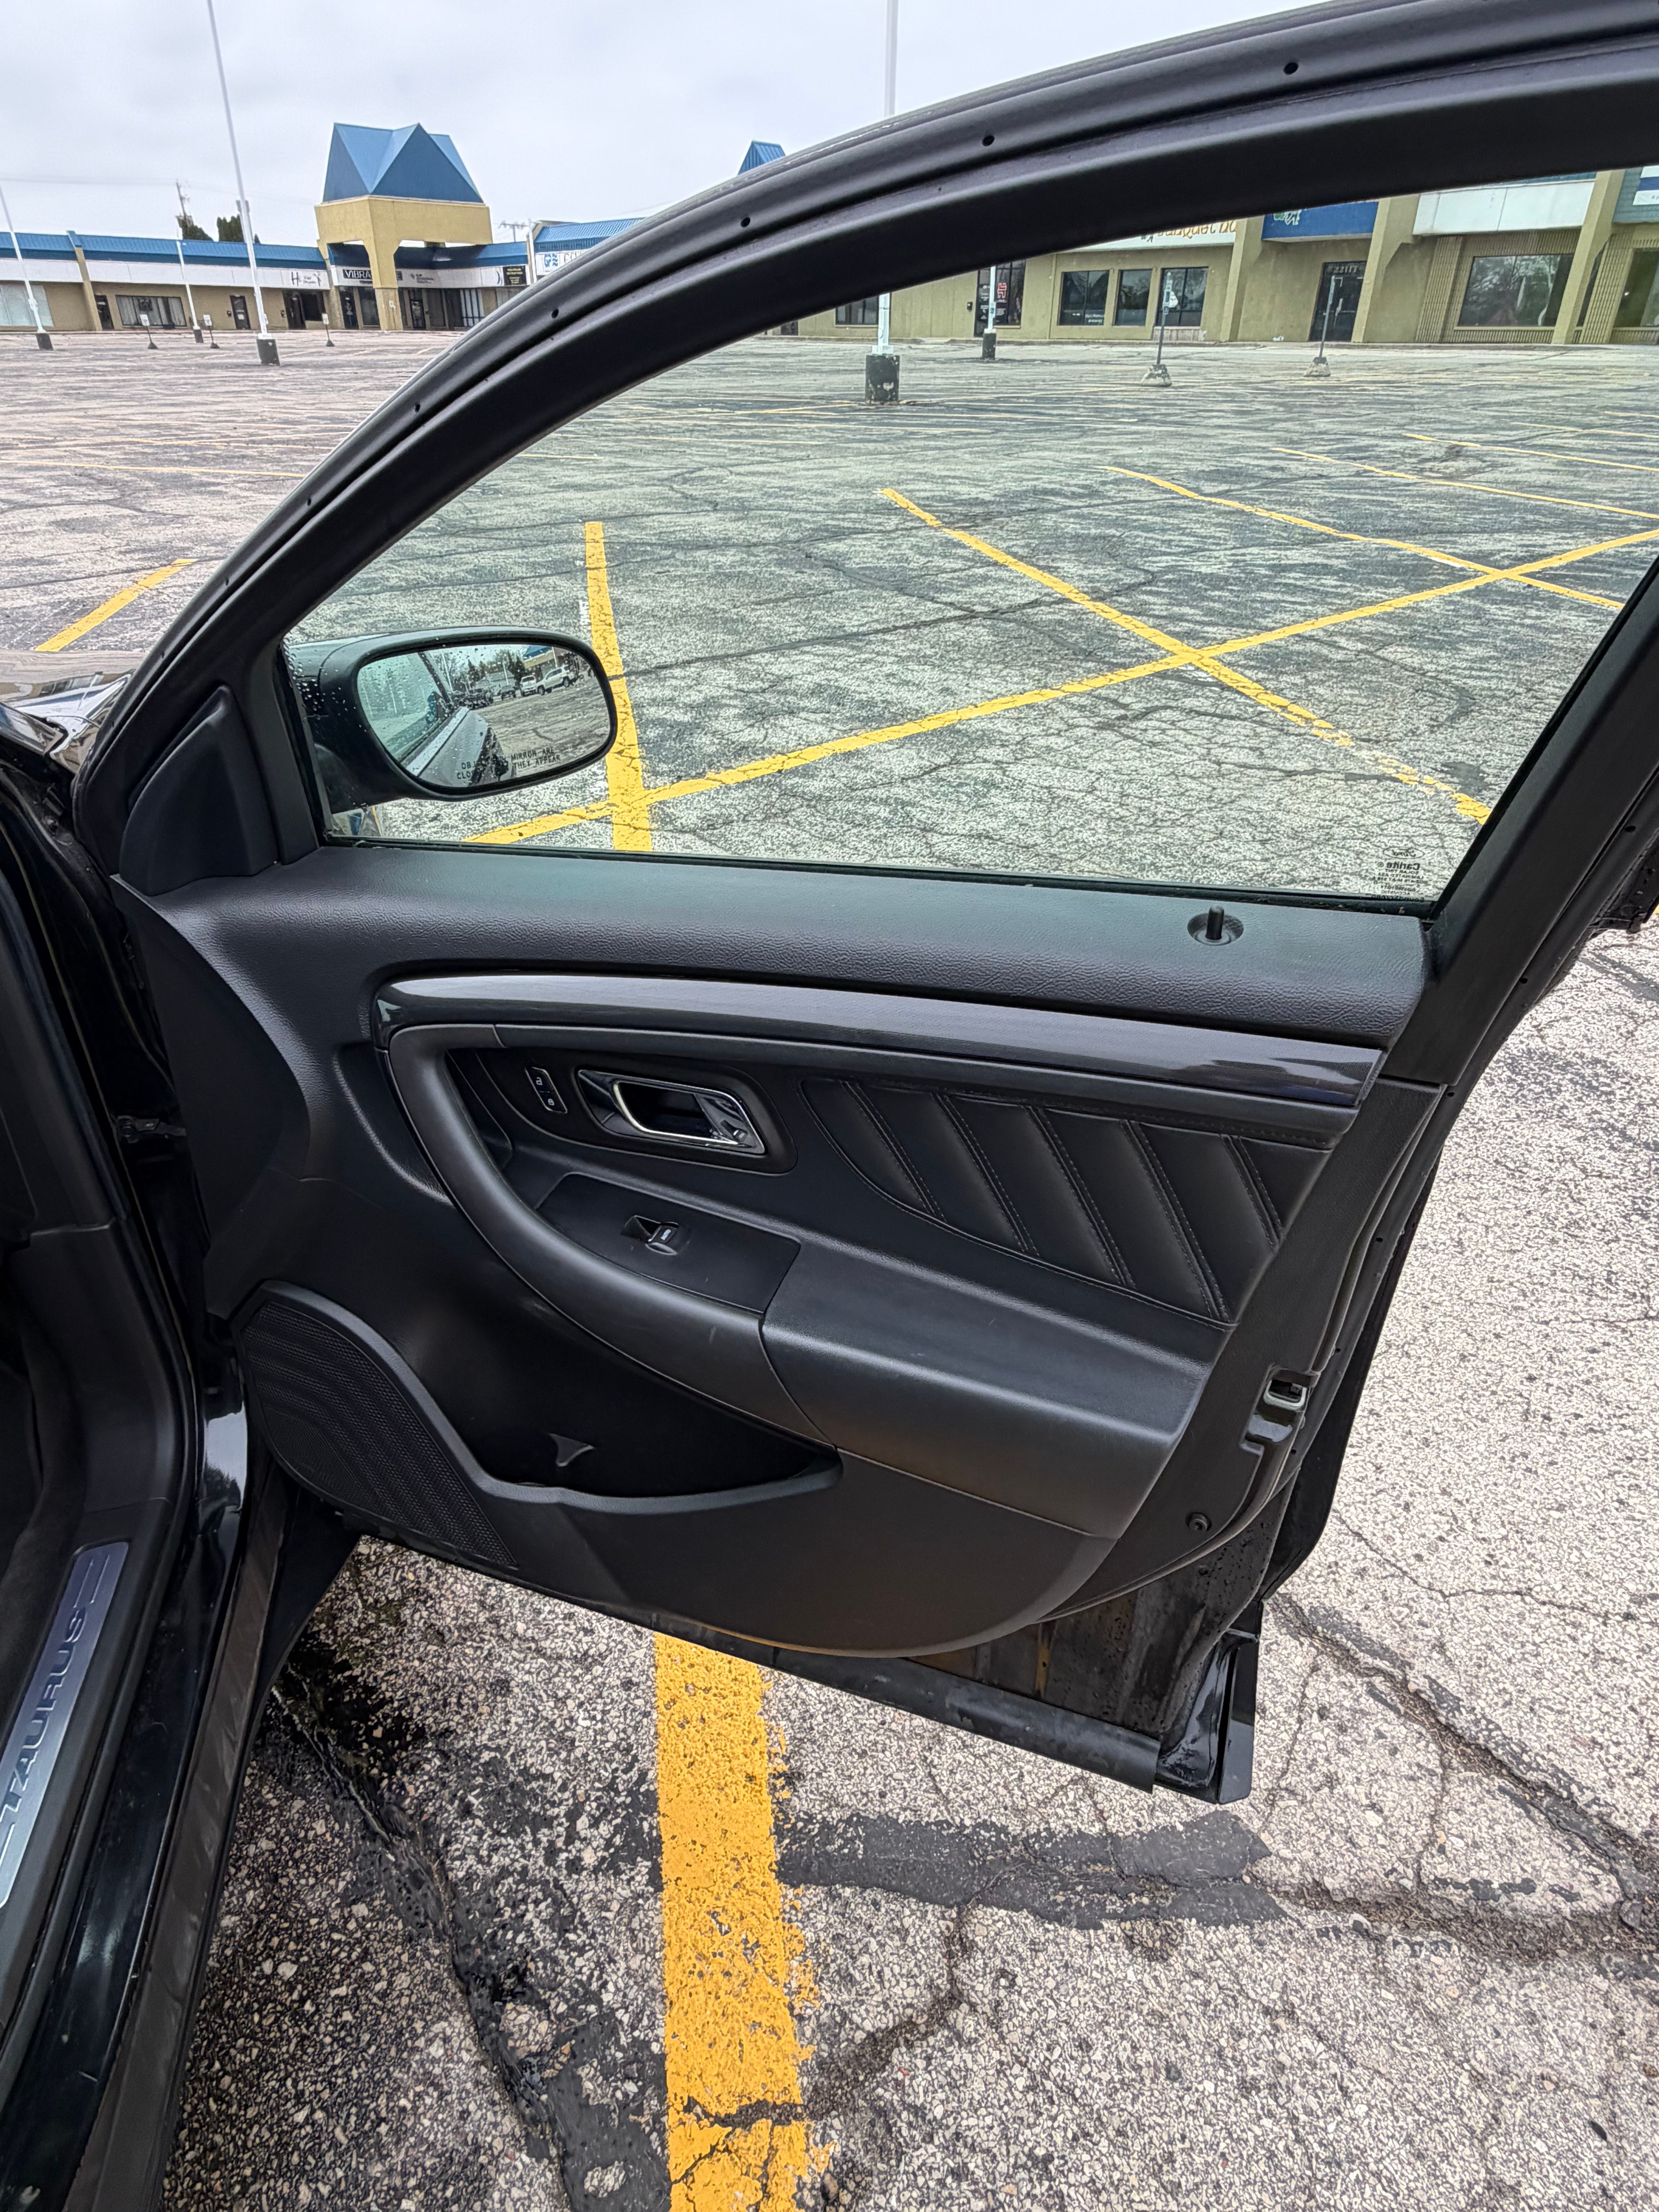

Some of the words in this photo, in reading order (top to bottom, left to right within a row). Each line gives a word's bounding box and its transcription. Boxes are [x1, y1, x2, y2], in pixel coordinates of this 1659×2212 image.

[511, 749, 537, 761] MIRROR
[543, 747, 555, 756] ARE
[514, 760, 531, 769] THEY
[535, 754, 561, 766] APPEAR
[0, 1607, 86, 1821] TAURUS
